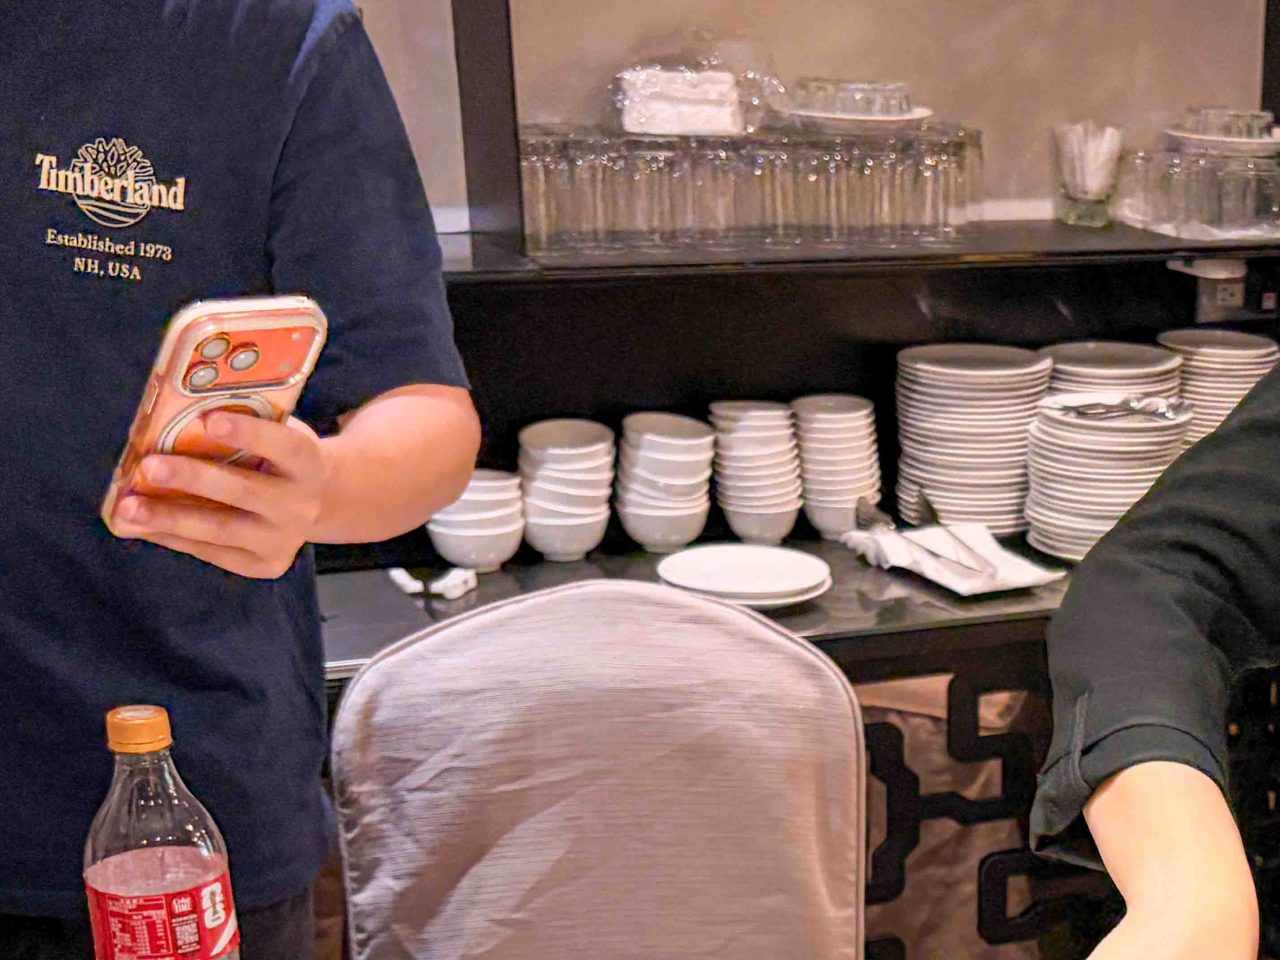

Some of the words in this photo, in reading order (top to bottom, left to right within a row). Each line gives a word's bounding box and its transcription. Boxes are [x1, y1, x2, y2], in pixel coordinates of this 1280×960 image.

[35, 153, 186, 211] Timberland
[46, 229, 135, 256] Established
[108, 262, 141, 280] USA
